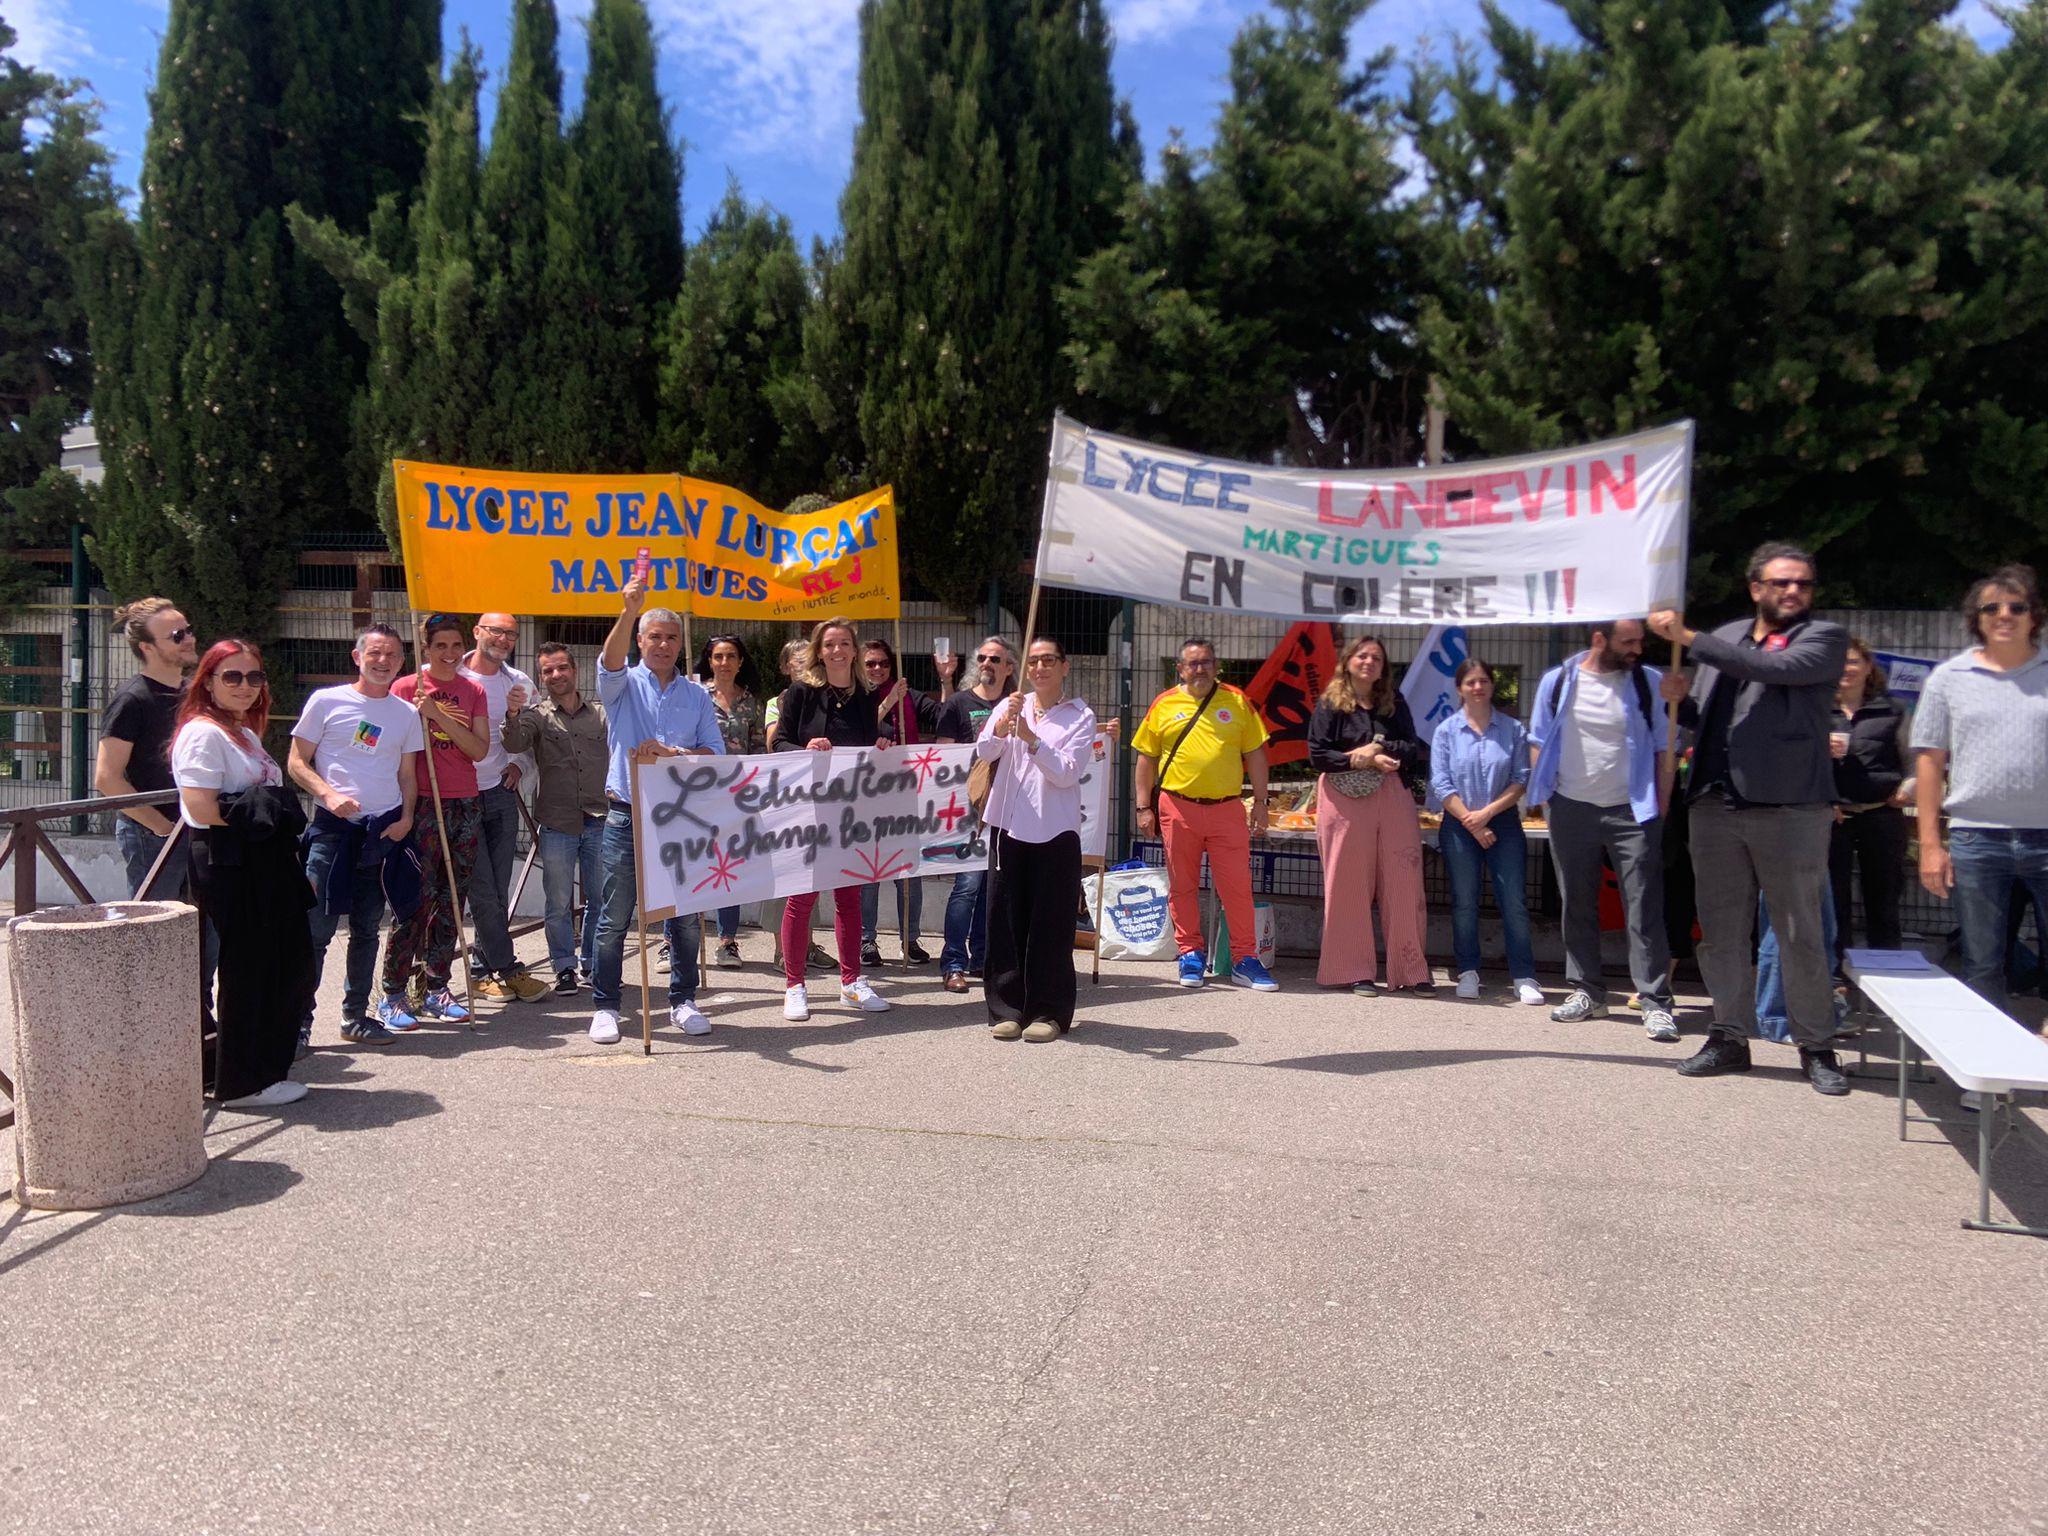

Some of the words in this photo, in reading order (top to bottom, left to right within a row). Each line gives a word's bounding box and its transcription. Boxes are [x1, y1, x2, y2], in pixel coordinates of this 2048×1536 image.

[1084, 439, 1251, 512] LYCÉE
[1317, 454, 1638, 529] LANGEVIN
[424, 482, 572, 535] LYCEE
[586, 492, 708, 540] JEAN
[715, 507, 881, 572] LURÇAT
[1180, 551, 1245, 609] EN
[1524, 568, 1579, 618] !!!
[660, 820, 717, 885] qui
[726, 813, 832, 865] change
